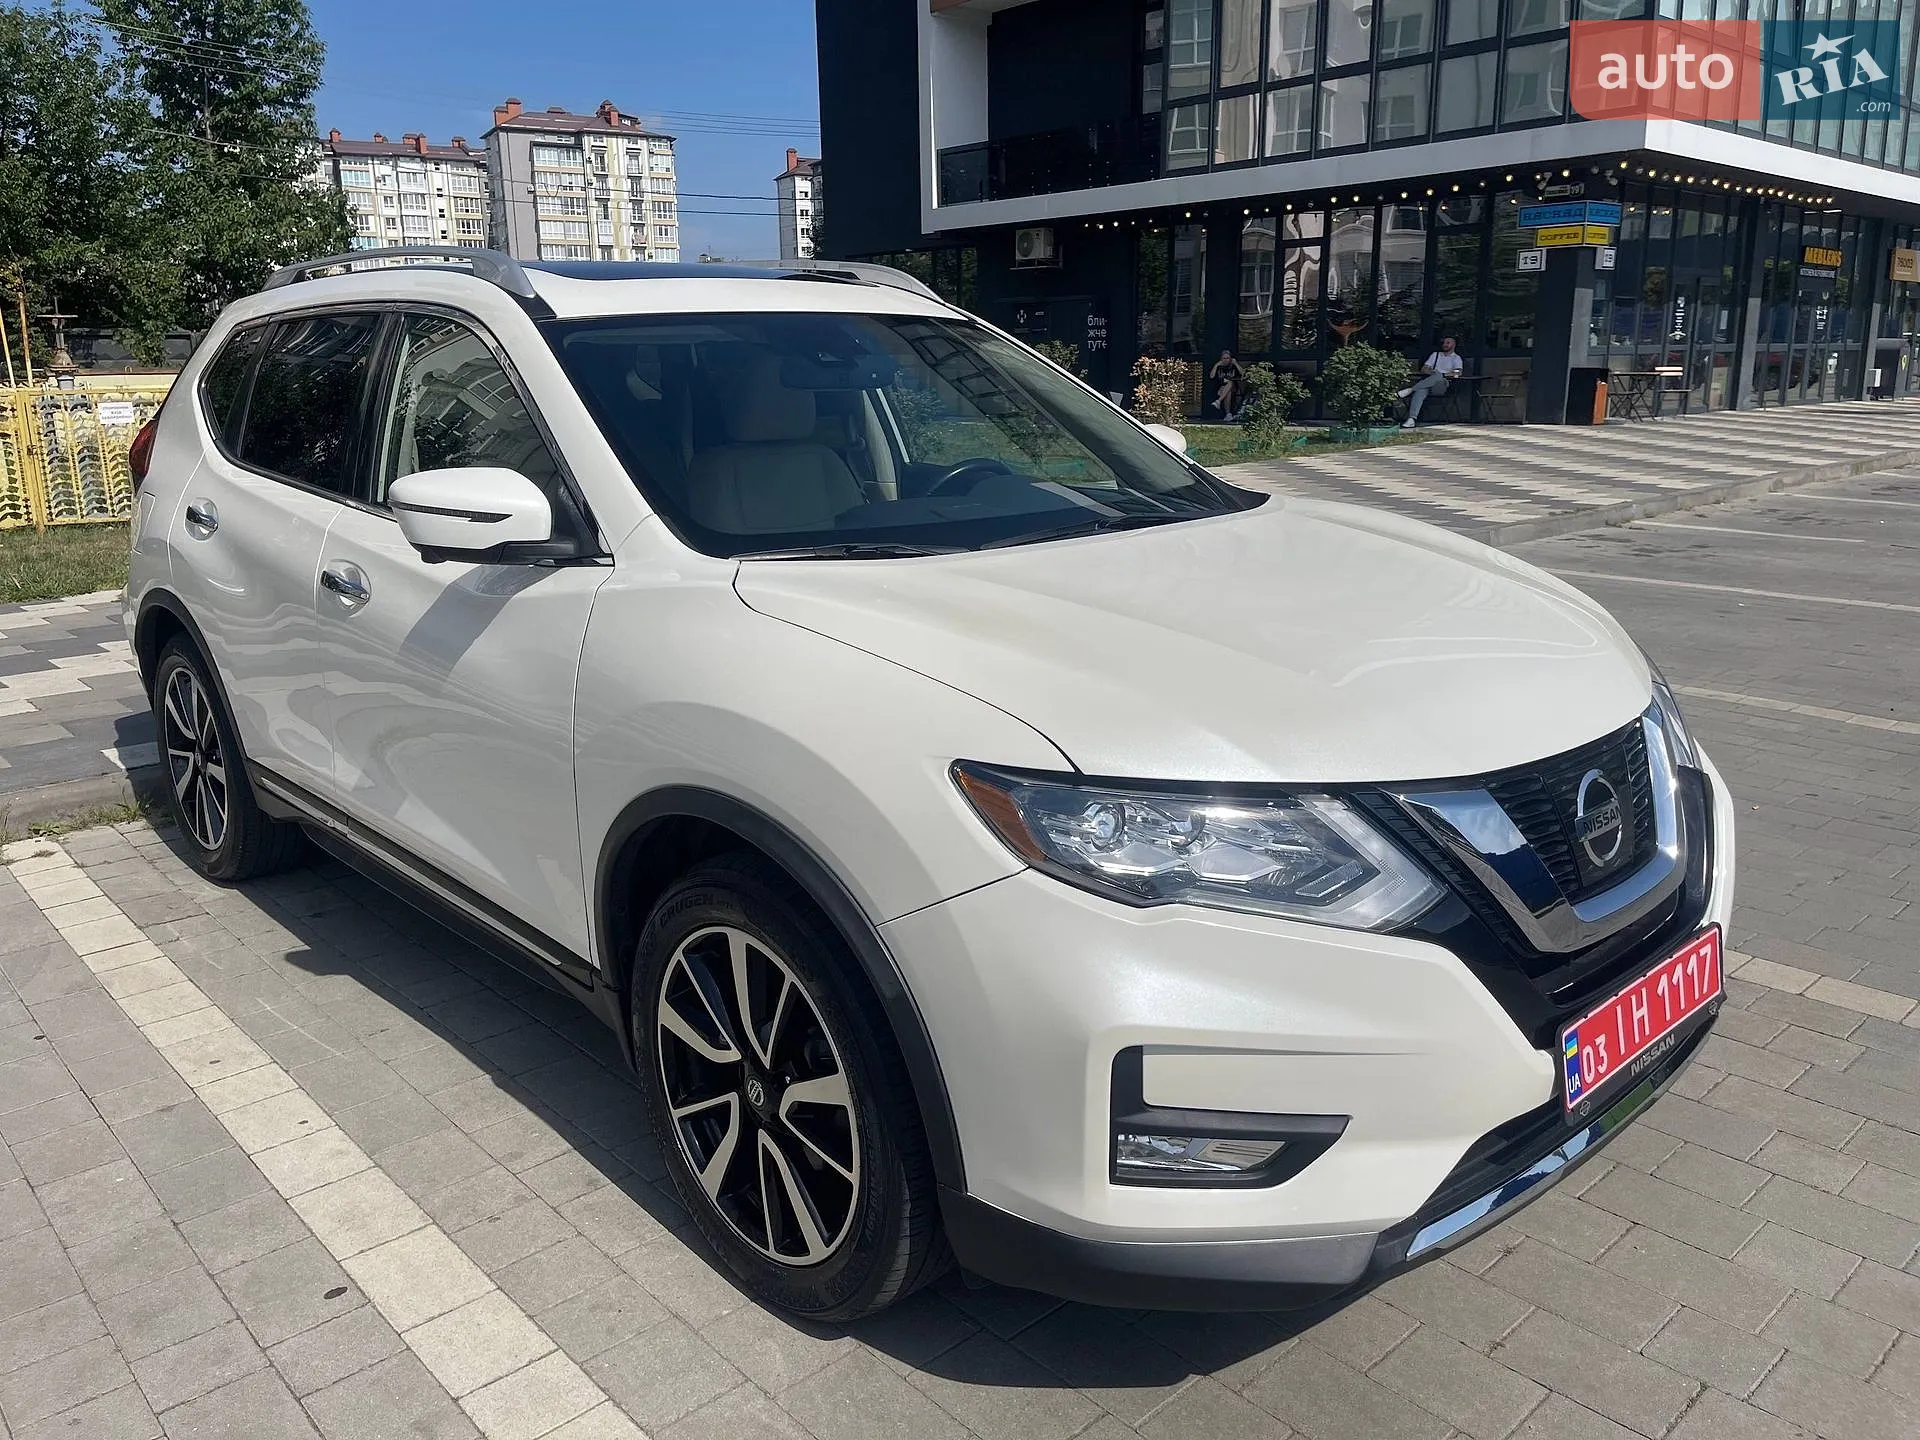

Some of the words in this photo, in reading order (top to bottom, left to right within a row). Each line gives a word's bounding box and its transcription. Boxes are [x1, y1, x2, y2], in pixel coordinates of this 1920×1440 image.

[1087, 328, 1107, 338] жче
[1583, 803, 1621, 833] NISSAN
[1582, 1033, 1608, 1084] 03
[1615, 986, 1650, 1056] IH
[1656, 943, 1712, 1022] 1117
[1630, 1033, 1676, 1077] NISSAN
[1568, 1077, 1582, 1094] UA
